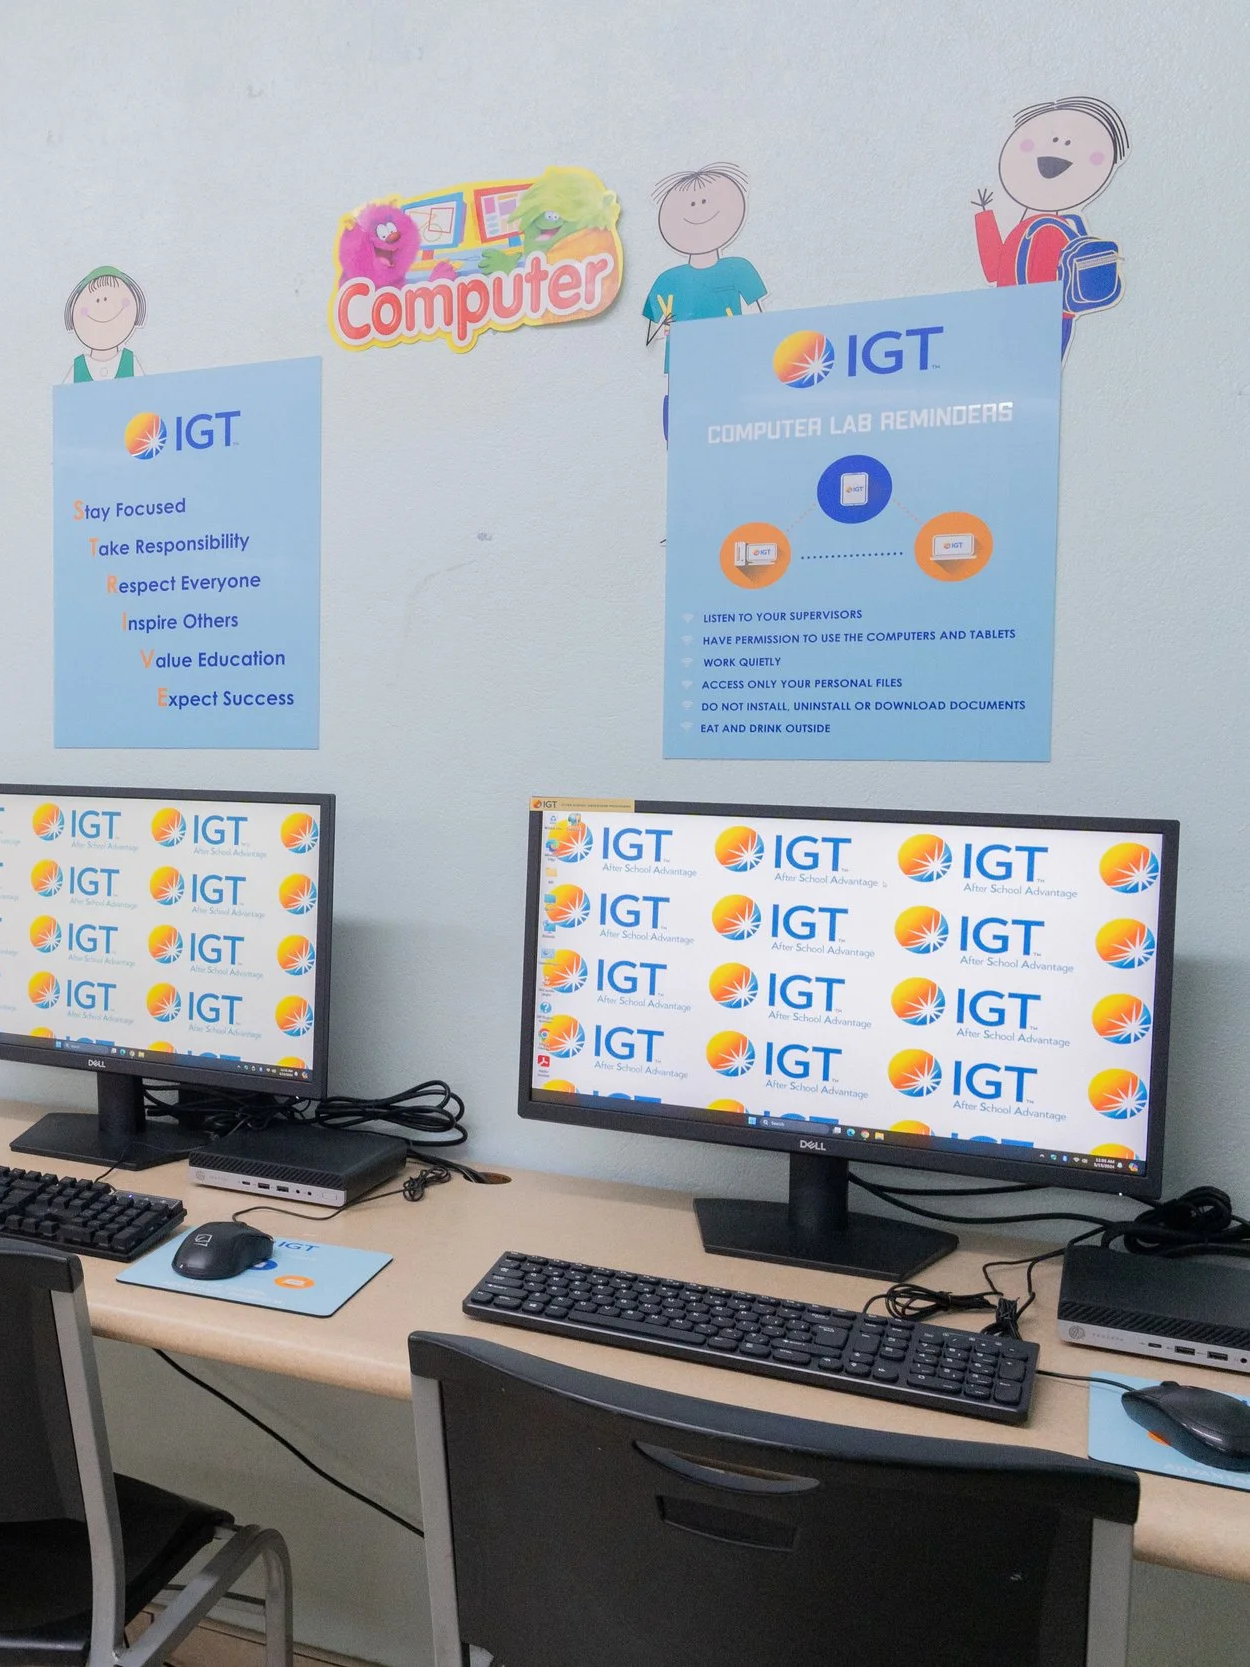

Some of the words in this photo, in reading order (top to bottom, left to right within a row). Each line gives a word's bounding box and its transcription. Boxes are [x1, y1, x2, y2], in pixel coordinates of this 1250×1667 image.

[338, 256, 608, 341] Computer
[848, 326, 944, 377] IGT
[176, 411, 240, 451] IGT
[707, 418, 821, 444] COMPUTER
[830, 414, 871, 436] LAB
[881, 402, 1013, 432] REMINDERS
[73, 501, 109, 522] Stay
[117, 498, 186, 518] Focused
[90, 538, 129, 558] Take
[136, 533, 249, 556] Responsibility
[107, 575, 176, 596] Respect
[182, 574, 261, 594] Everyone
[122, 612, 177, 634] Inspire
[183, 612, 238, 629] Others
[704, 614, 735, 623] LISTEN
[739, 613, 752, 622] TO
[757, 612, 786, 621] YOUR
[790, 610, 862, 620] SUPERVISORS
[703, 636, 732, 645] HAVE
[736, 635, 799, 644] PERMISSION
[803, 634, 817, 643] TO
[822, 634, 840, 642] USE
[844, 633, 863, 642] THE
[867, 631, 935, 641] COMPUTERS
[940, 631, 966, 640] AND
[970, 629, 1015, 639] TABLETS
[140, 649, 192, 669] Value
[199, 651, 285, 668] Education
[704, 658, 735, 667] WORK
[739, 657, 781, 667] QUIETLY
[702, 681, 744, 689] ACCESS
[748, 680, 777, 688] ONLY
[781, 680, 810, 688] YOUR
[815, 679, 872, 688] PERSONAL
[876, 679, 902, 687] FILES
[158, 688, 218, 709] Expect
[223, 690, 294, 706] Success
[702, 703, 718, 711] DO
[722, 703, 743, 711] NOT
[794, 702, 851, 710] UNINSTALL
[855, 702, 870, 710] OR
[875, 701, 945, 710] DOWNLOAD
[950, 701, 1025, 710] DOCUMENTS
[701, 724, 719, 733] EAT
[722, 724, 746, 732] AND
[750, 724, 781, 733] DRINK
[786, 724, 830, 733] OUTSIDE
[71, 810, 120, 839] IGT
[193, 816, 247, 845] IGT
[602, 827, 673, 862] IGT
[774, 834, 852, 872] IGT
[602, 863, 622, 872] After
[625, 864, 651, 873] School
[653, 866, 697, 878] Advantage
[963, 843, 1048, 882] IGT
[69, 867, 119, 896] IGT
[192, 874, 245, 904] IGT
[775, 872, 797, 881] After
[799, 873, 828, 884] School
[830, 876, 878, 888] Advantage
[963, 883, 987, 892] After
[990, 884, 1022, 894] School
[1025, 886, 1078, 899] Advantage
[600, 893, 670, 929] IGT
[771, 904, 849, 942] IGT
[68, 924, 118, 953] IGT
[600, 927, 619, 938] After
[622, 930, 648, 940] School
[649, 933, 694, 945] Advantage
[960, 915, 1045, 956] IGT
[190, 933, 244, 965] IGT
[771, 942, 793, 951] After
[796, 943, 824, 953] School
[827, 946, 875, 959] Advantage
[960, 956, 984, 965] After
[987, 957, 1018, 968] School
[1021, 960, 1074, 974] Advantage
[597, 960, 667, 996] IGT
[66, 980, 116, 1011] IGT
[597, 995, 616, 1004] After
[619, 996, 646, 1007] School
[647, 1000, 691, 1013] Advantage
[768, 973, 846, 1012] IGT
[189, 992, 242, 1024] IGT
[768, 1010, 790, 1020] After
[793, 1012, 821, 1023] School
[824, 1016, 872, 1029] Advantage
[957, 988, 1041, 1030] IGT
[594, 1024, 665, 1063] IGT
[957, 1028, 981, 1038] After
[983, 1030, 1015, 1041] School
[1018, 1033, 1070, 1048] Advantage
[88, 1060, 106, 1068] DELL
[594, 1061, 614, 1070] After
[616, 1063, 643, 1073] School
[645, 1066, 688, 1080] Advantage
[765, 1041, 843, 1082] IGT
[766, 1079, 787, 1089] After
[790, 1081, 818, 1093] School
[821, 1085, 868, 1100] Advantage
[953, 1060, 1038, 1103] IGT
[953, 1100, 977, 1110] After
[980, 1102, 1011, 1114] School
[1014, 1107, 1066, 1122] Advantage
[800, 1140, 826, 1151] DELL
[278, 1241, 320, 1251] IGT
